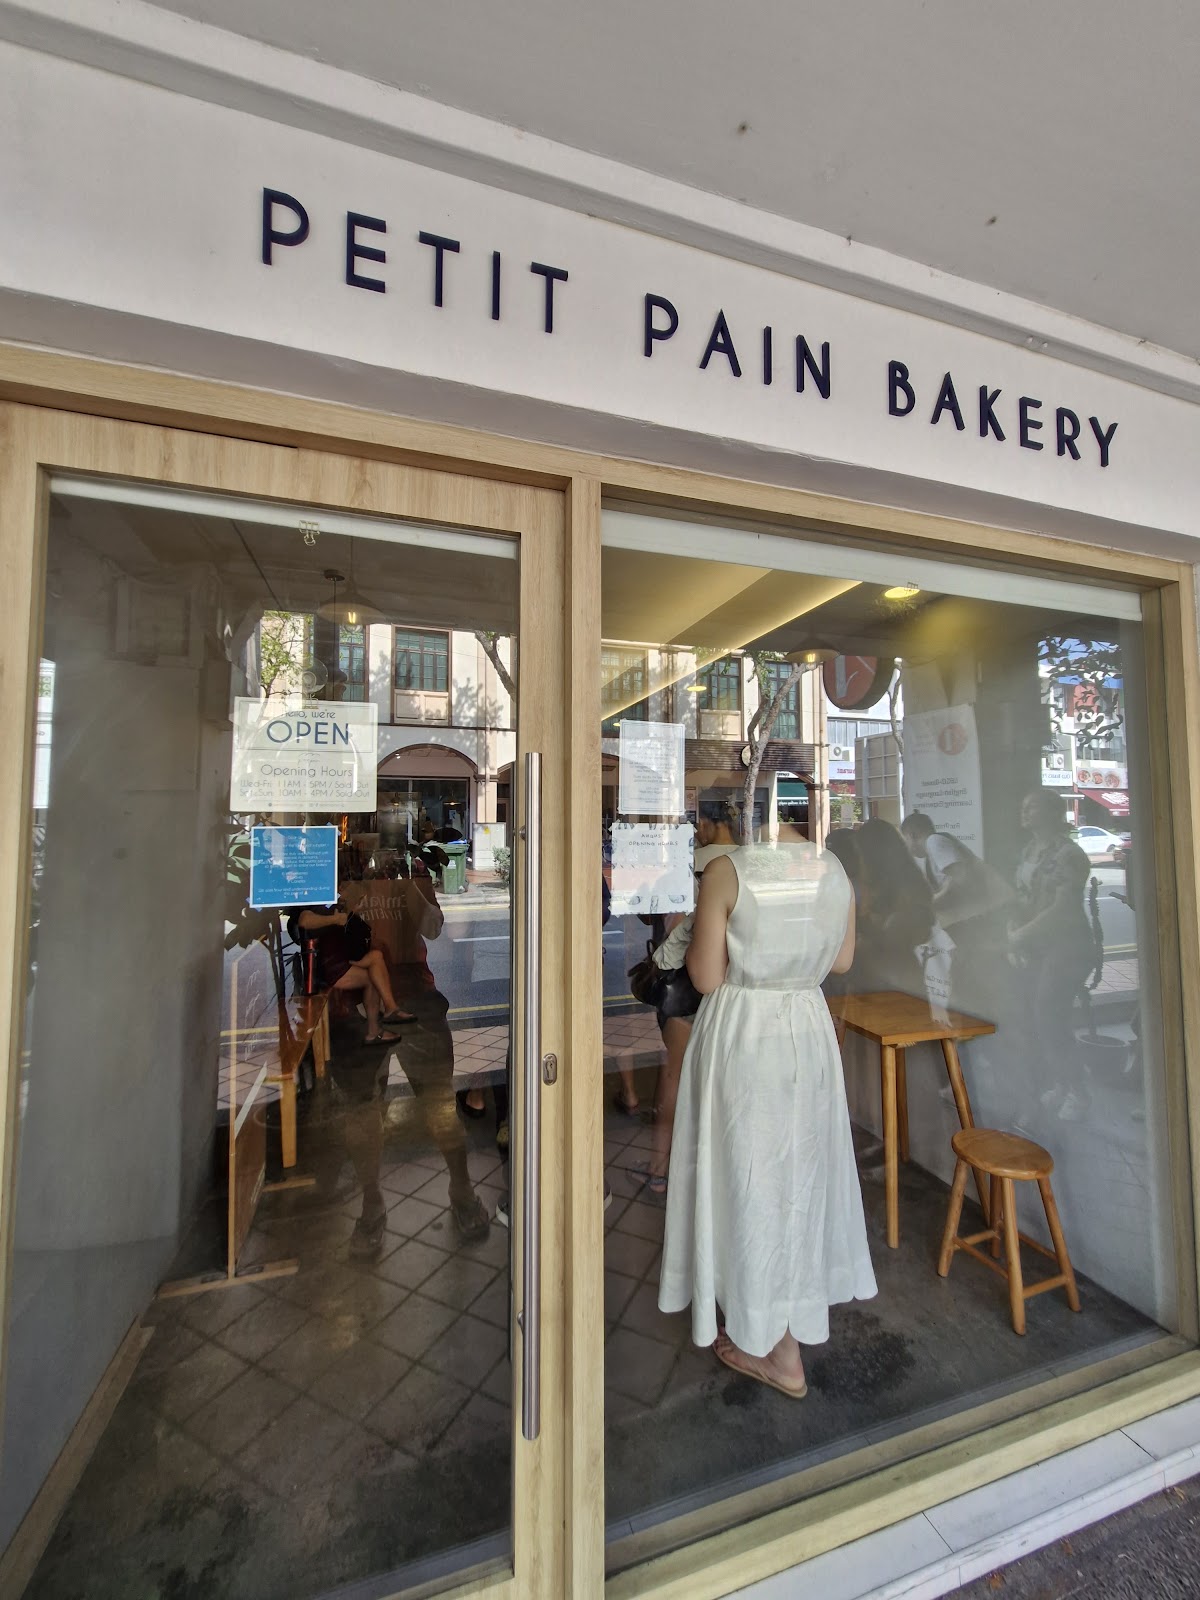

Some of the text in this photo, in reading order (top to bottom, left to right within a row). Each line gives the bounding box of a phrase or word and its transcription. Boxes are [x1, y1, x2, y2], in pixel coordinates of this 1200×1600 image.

[262, 188, 1118, 467] PETIT PAIN BAKERY
[311, 709, 336, 719] we're
[266, 720, 349, 745] OPEN
[260, 764, 353, 778] Opening Hours
[278, 780, 301, 788] 11AM
[309, 780, 327, 789] 5PM
[334, 780, 351, 789] Sold
[278, 789, 302, 798] 10AM
[310, 789, 327, 798] 4PM
[335, 790, 352, 799] Sold
